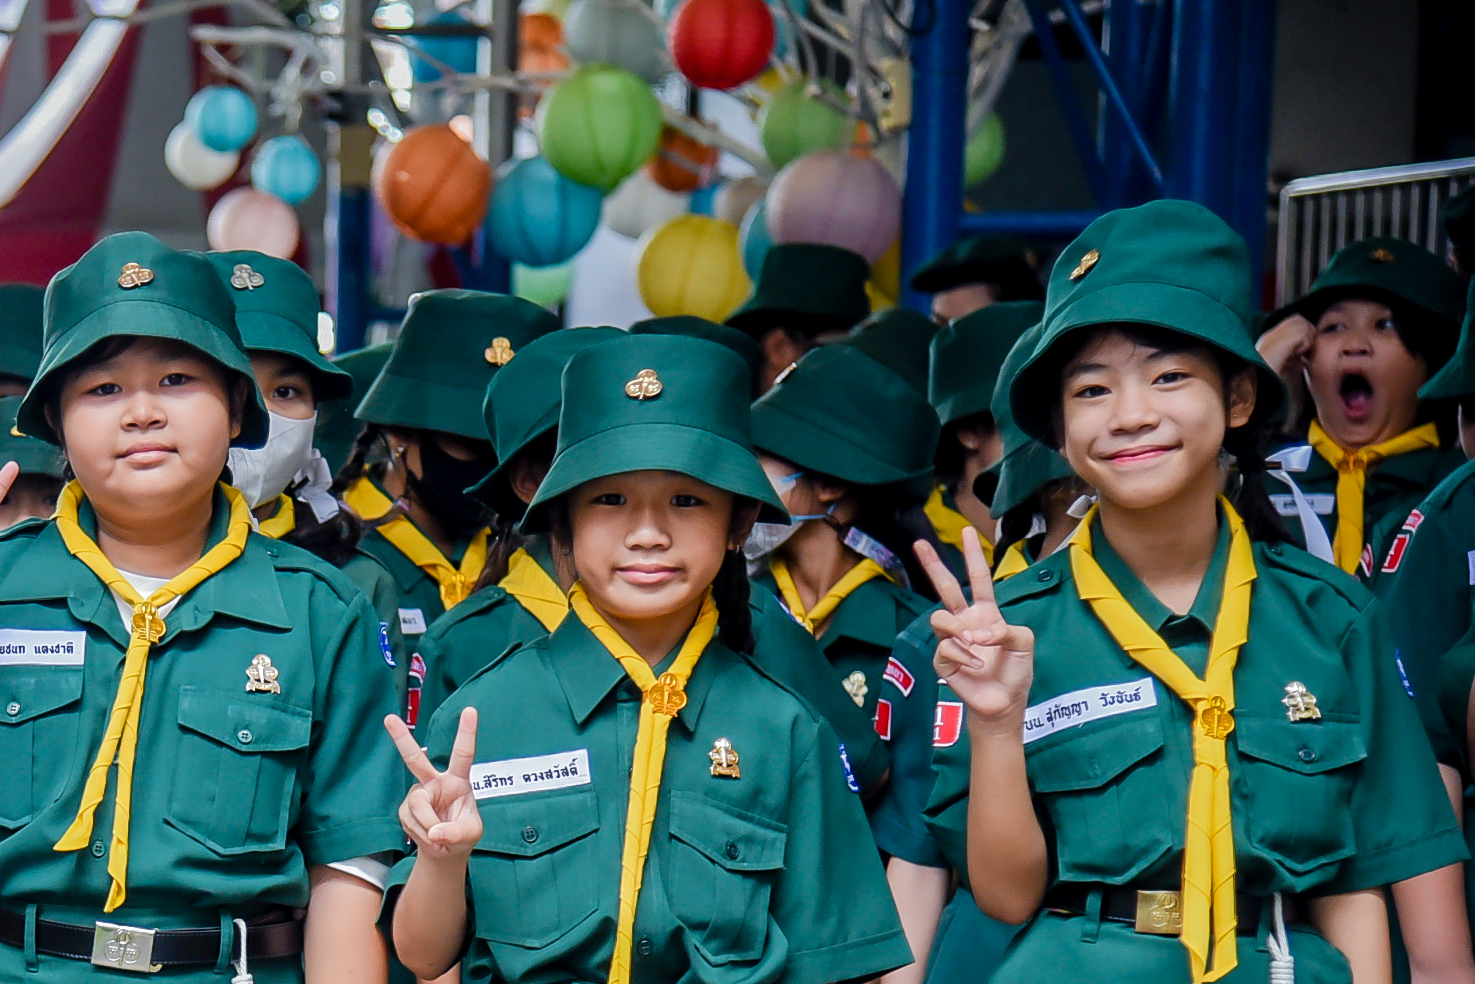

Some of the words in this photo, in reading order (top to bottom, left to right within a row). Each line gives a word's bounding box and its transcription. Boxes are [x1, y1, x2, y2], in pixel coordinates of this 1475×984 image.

[33, 641, 74, 655] แดงชาติ
[522, 757, 579, 784] ดวงสวัสดิ์
